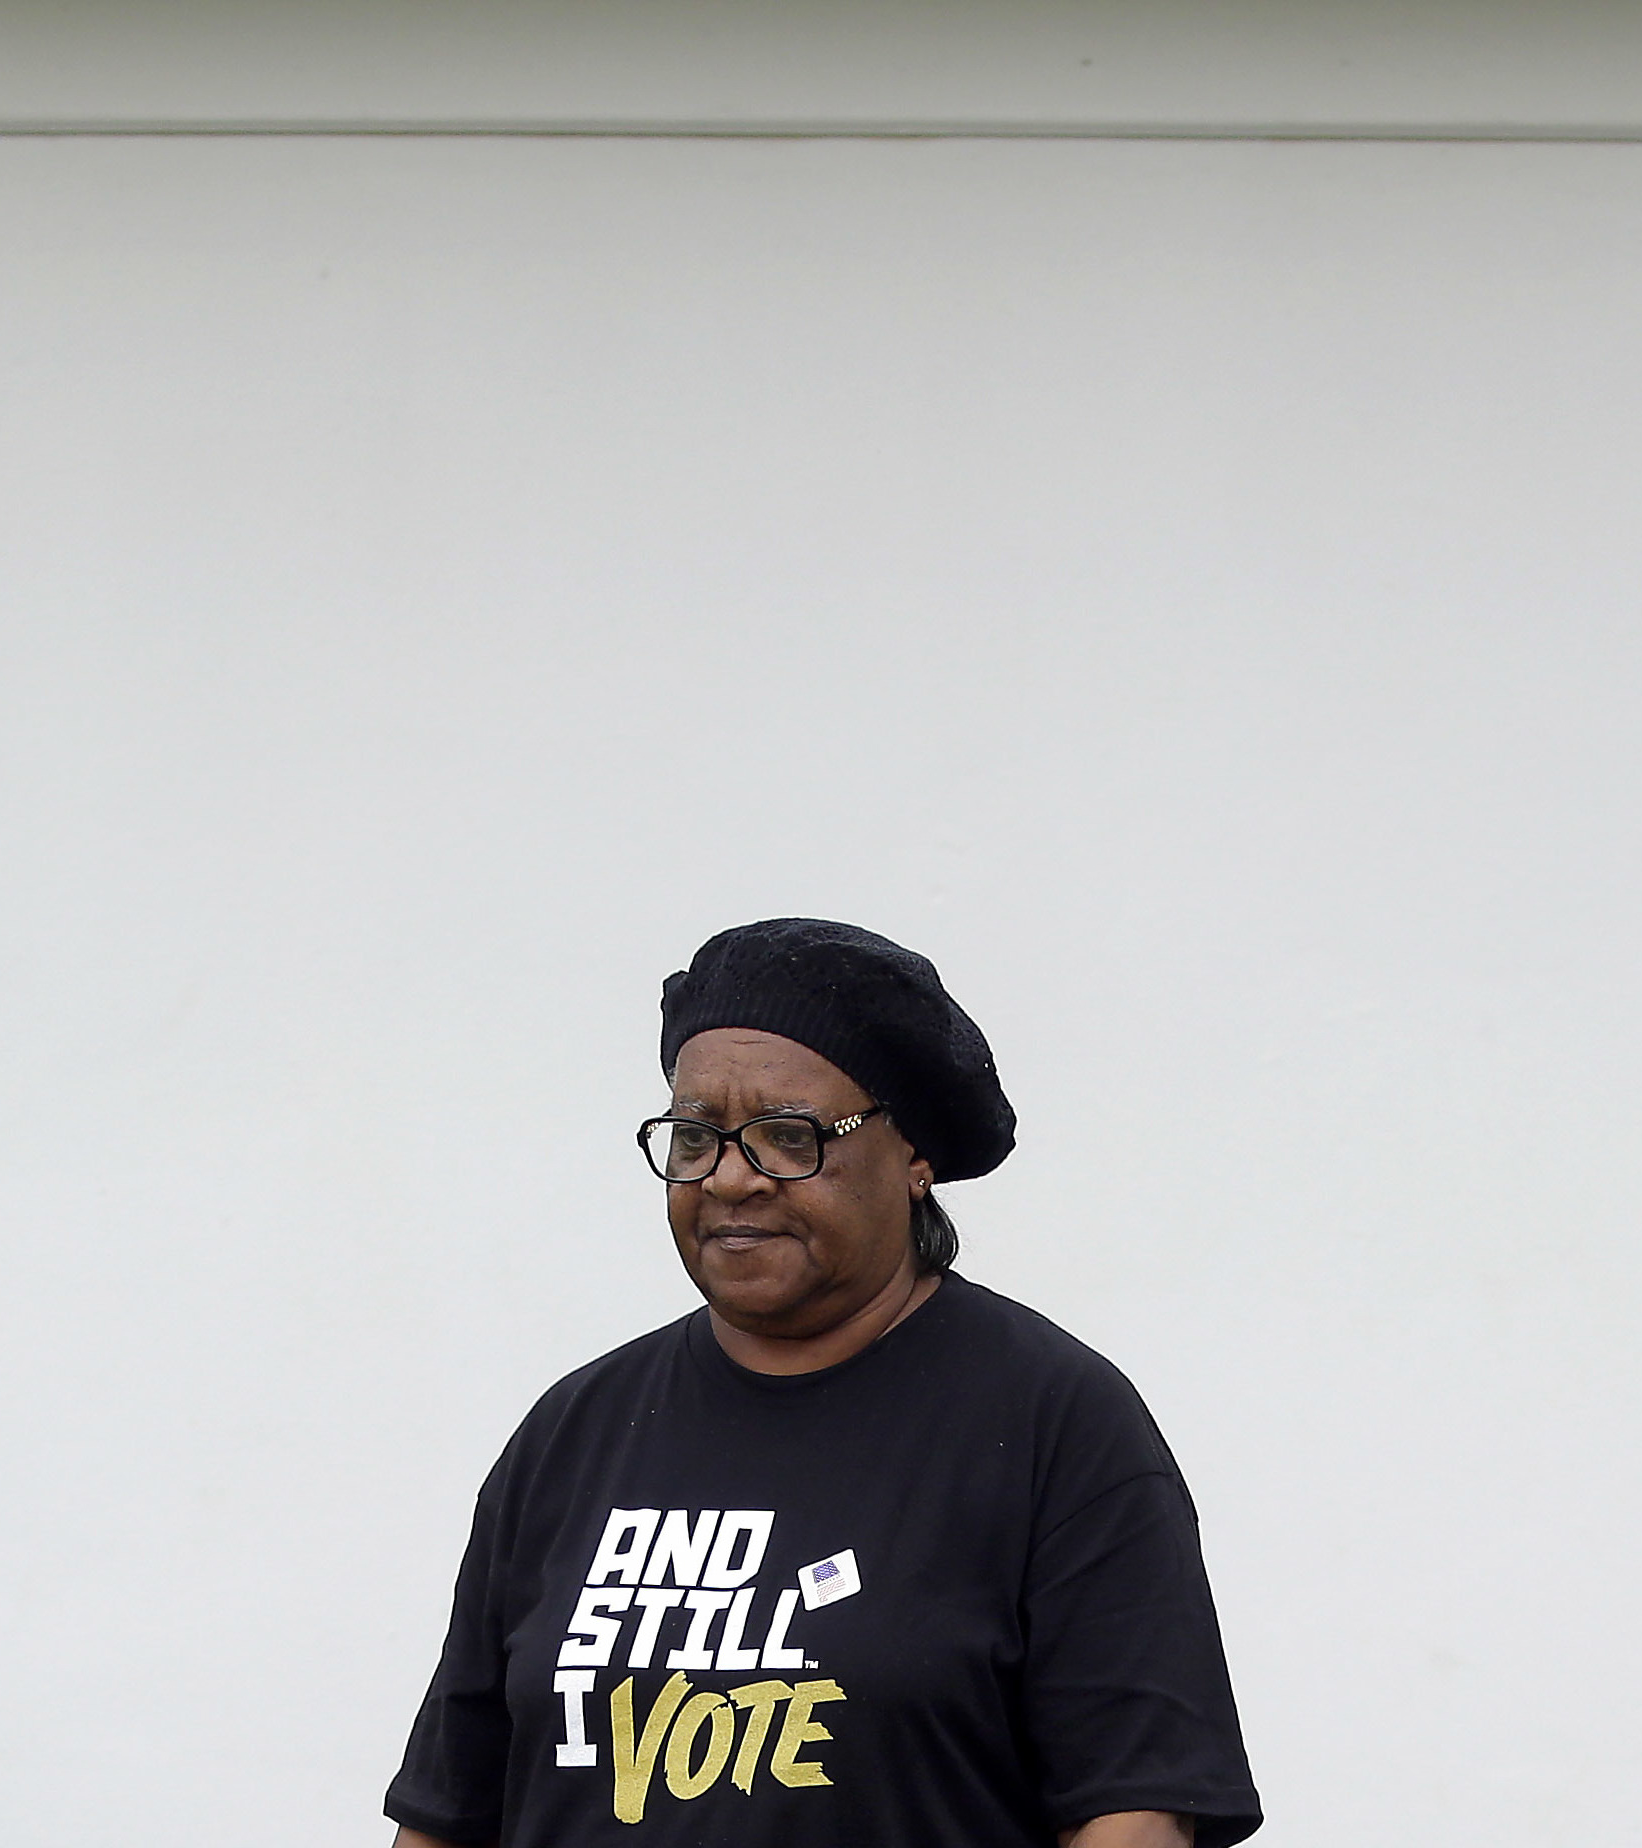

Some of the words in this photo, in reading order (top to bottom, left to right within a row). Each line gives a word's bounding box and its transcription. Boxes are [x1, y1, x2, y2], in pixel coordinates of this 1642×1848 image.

[585, 1507, 776, 1590] AND
[557, 1586, 805, 1670] STILL
[553, 1669, 598, 1767] I
[610, 1670, 848, 1824] VOTE
